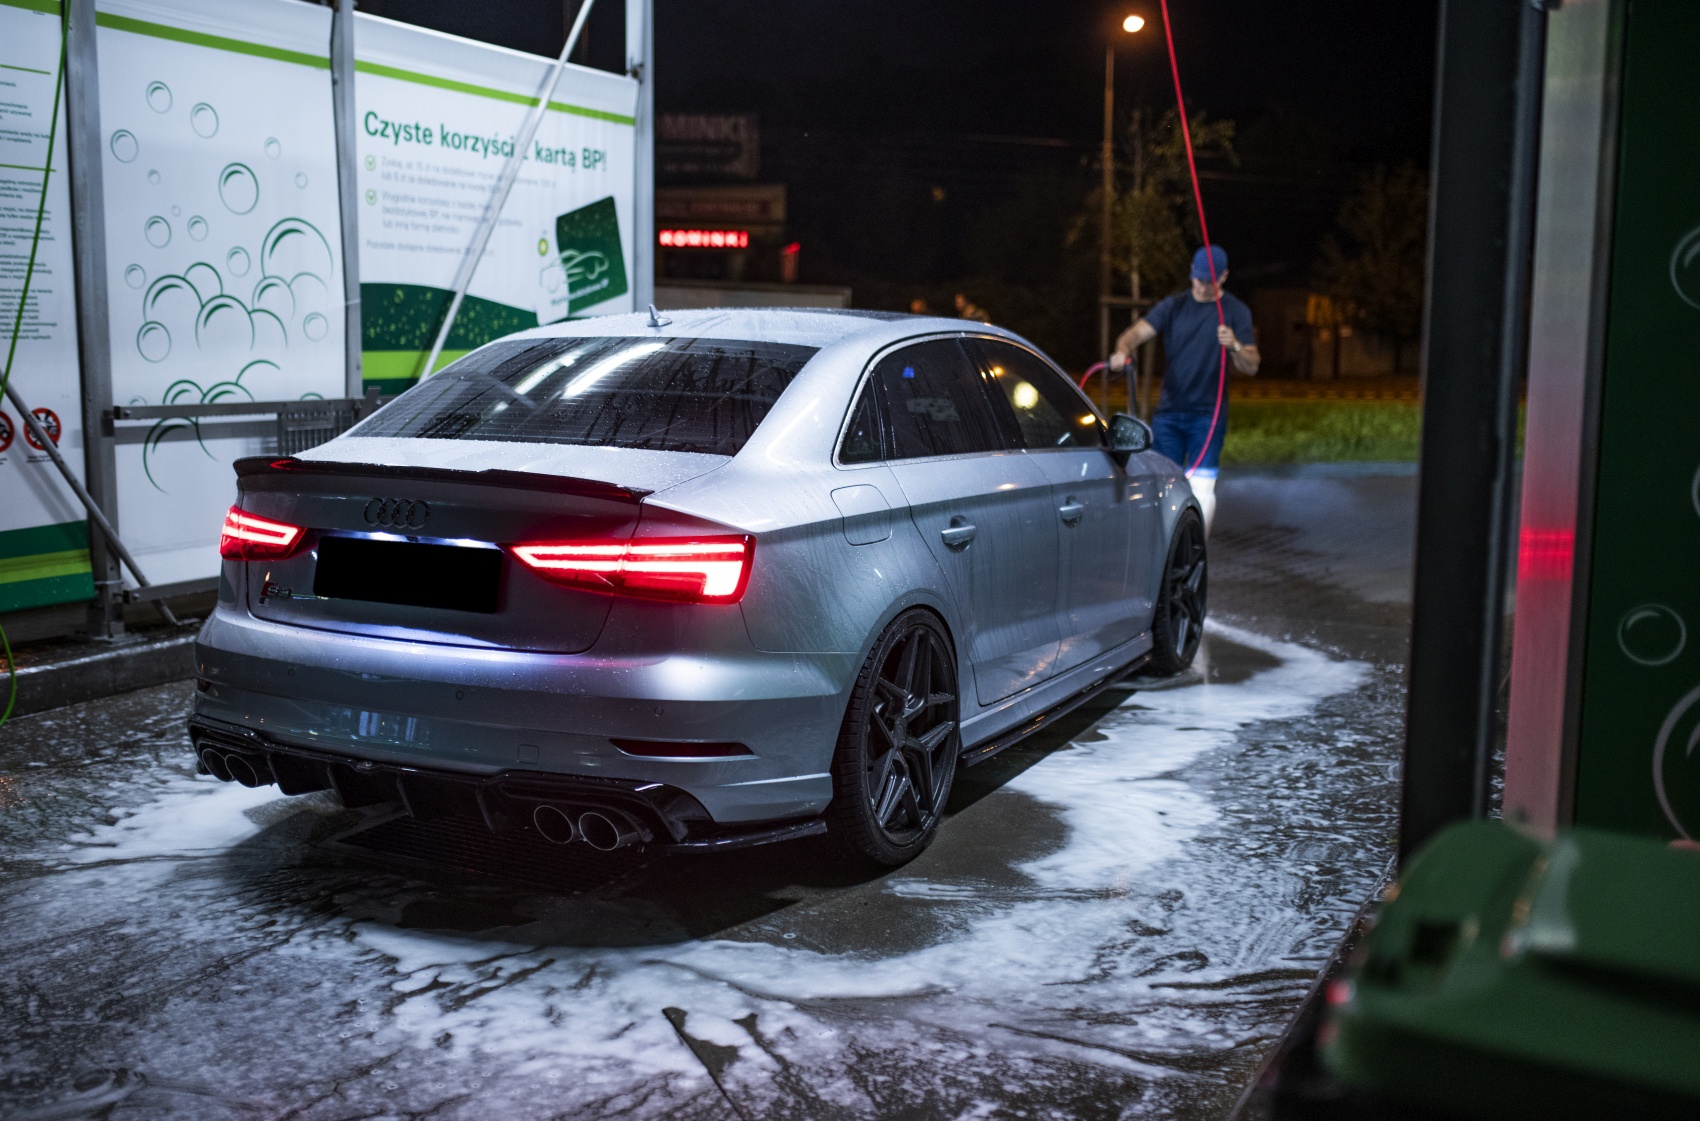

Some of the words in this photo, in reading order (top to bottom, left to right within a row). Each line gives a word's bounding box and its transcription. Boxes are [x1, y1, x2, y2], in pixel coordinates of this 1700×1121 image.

[655, 114, 746, 139] MINKI
[364, 111, 433, 146] Czyste
[440, 123, 515, 159] korzyści
[535, 141, 576, 174] kartą
[582, 147, 607, 172] BP!
[659, 230, 748, 248] KOMINKI
